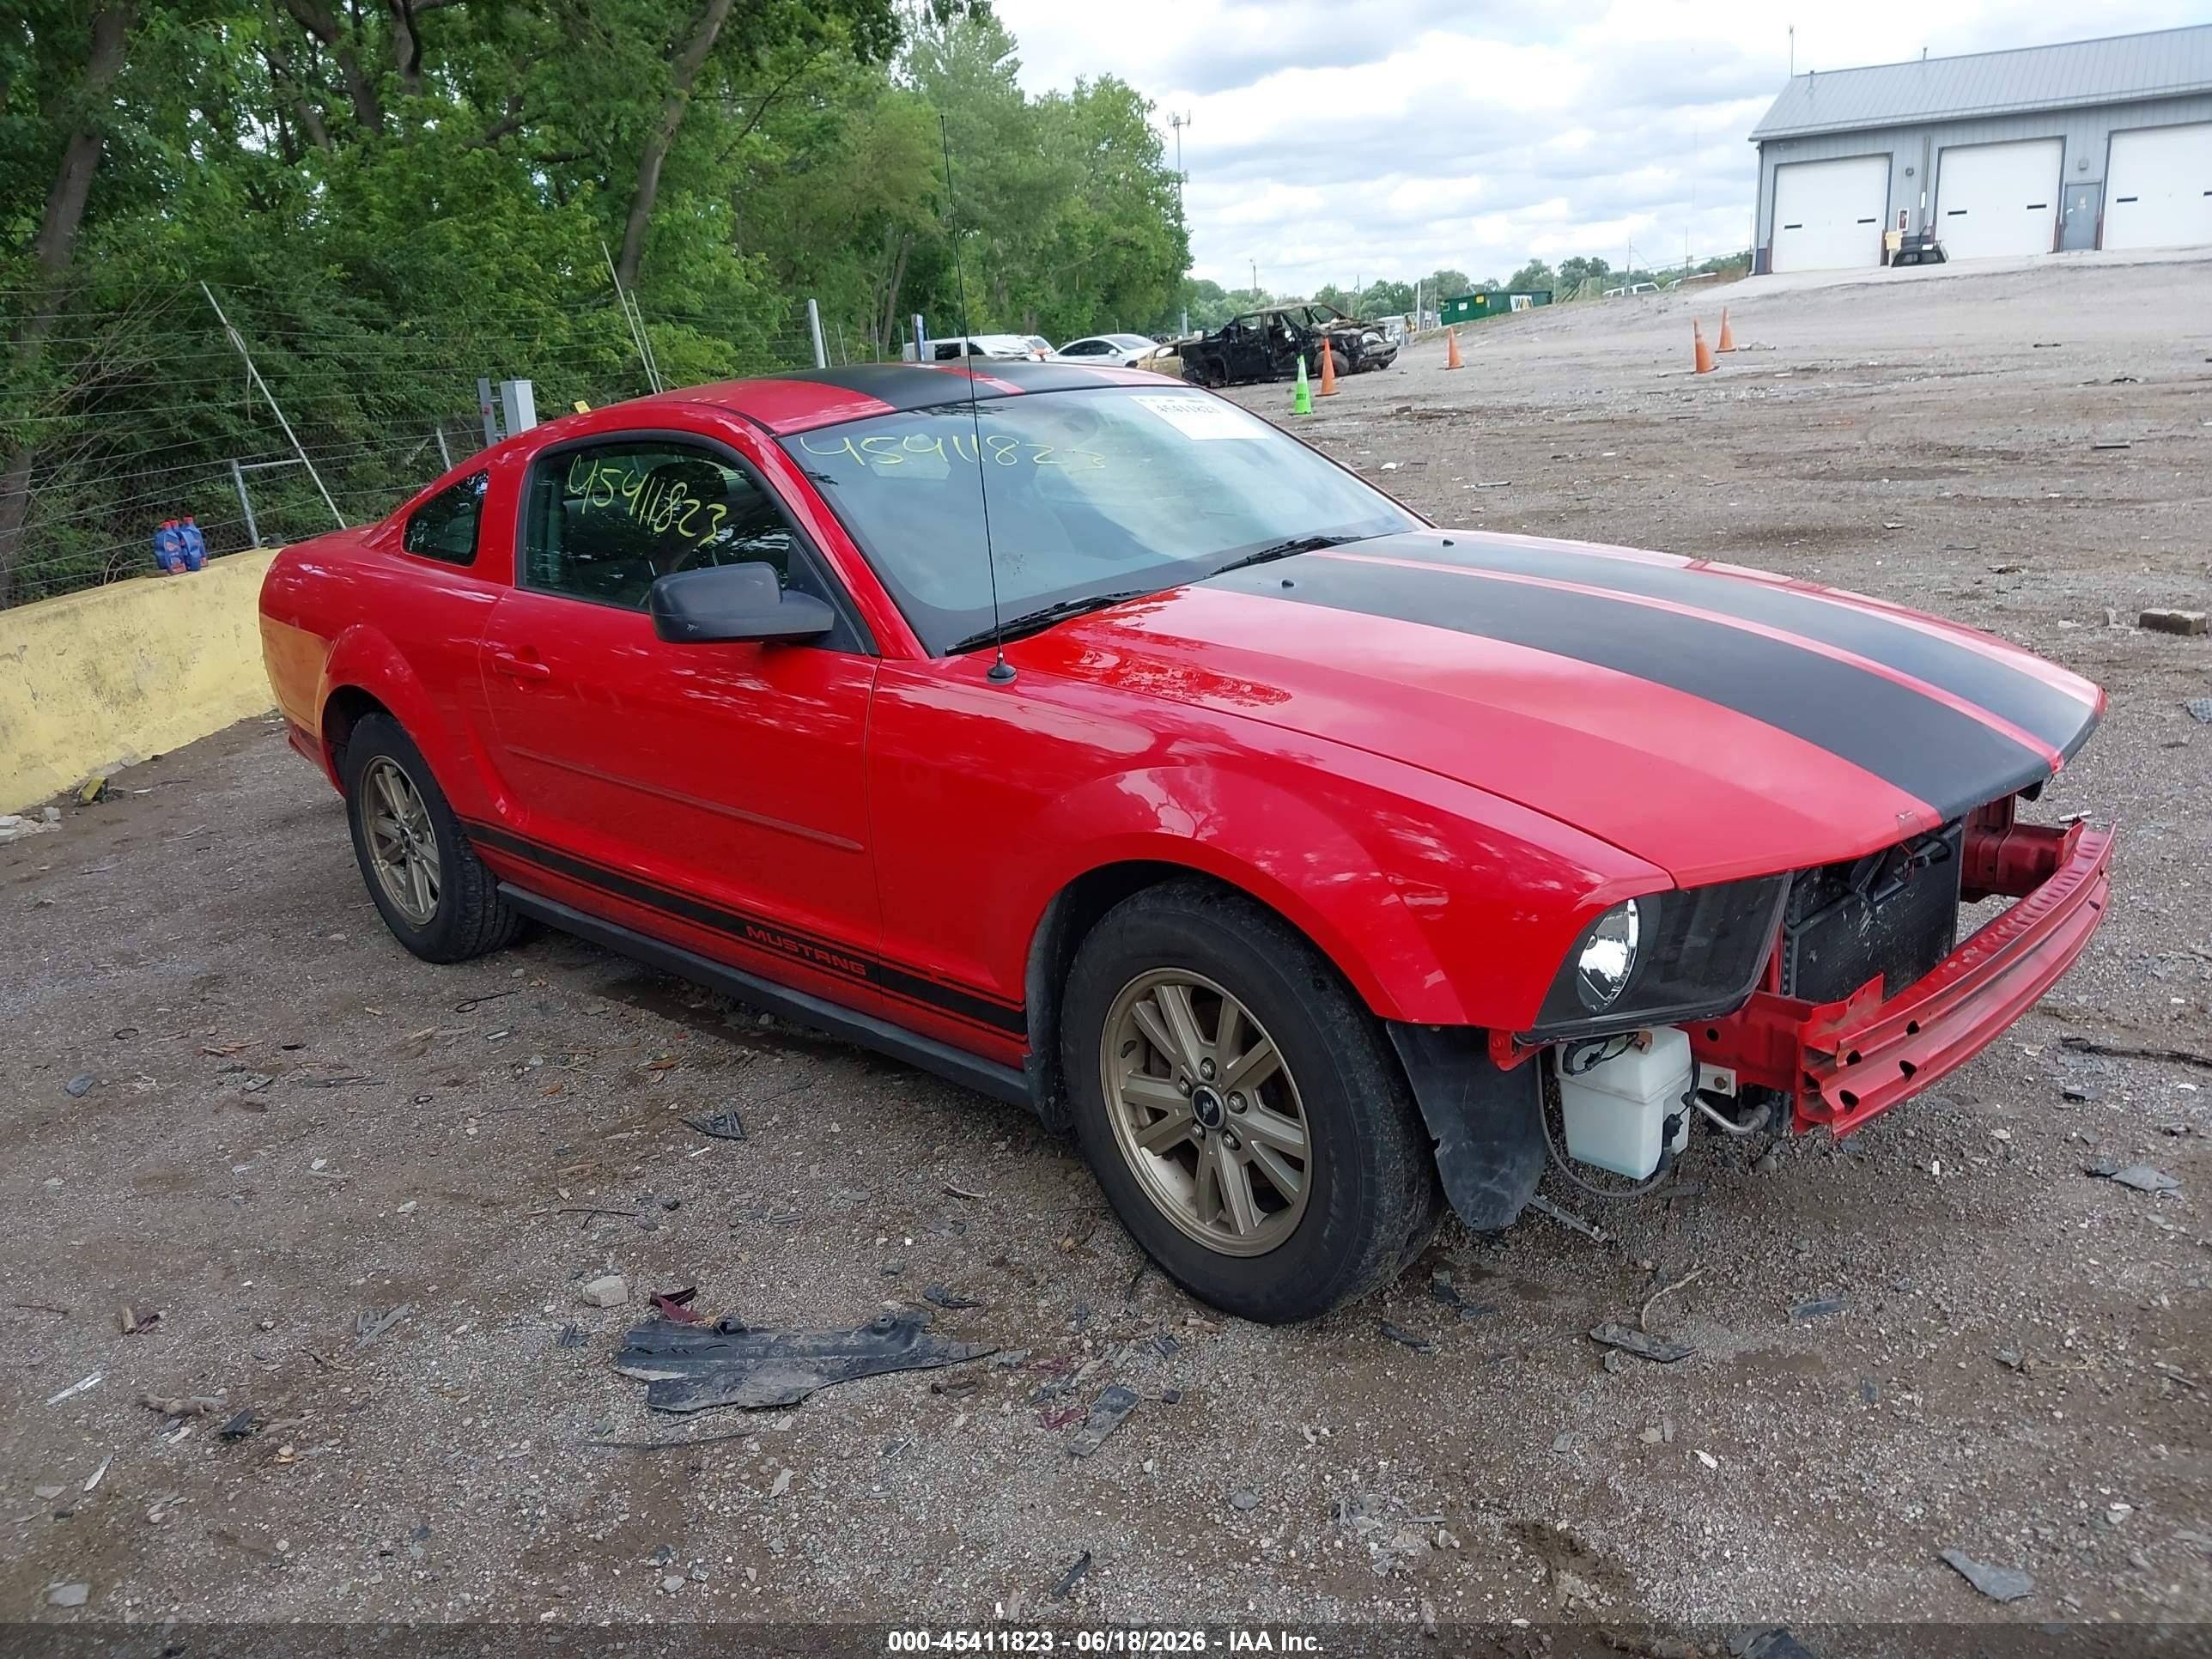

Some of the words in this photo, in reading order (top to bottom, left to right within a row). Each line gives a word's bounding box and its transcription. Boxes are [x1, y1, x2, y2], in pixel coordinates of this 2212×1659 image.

[800, 434, 1106, 473] 45411823
[568, 453, 727, 547] 45411823
[745, 925, 866, 976] MUSTANG
